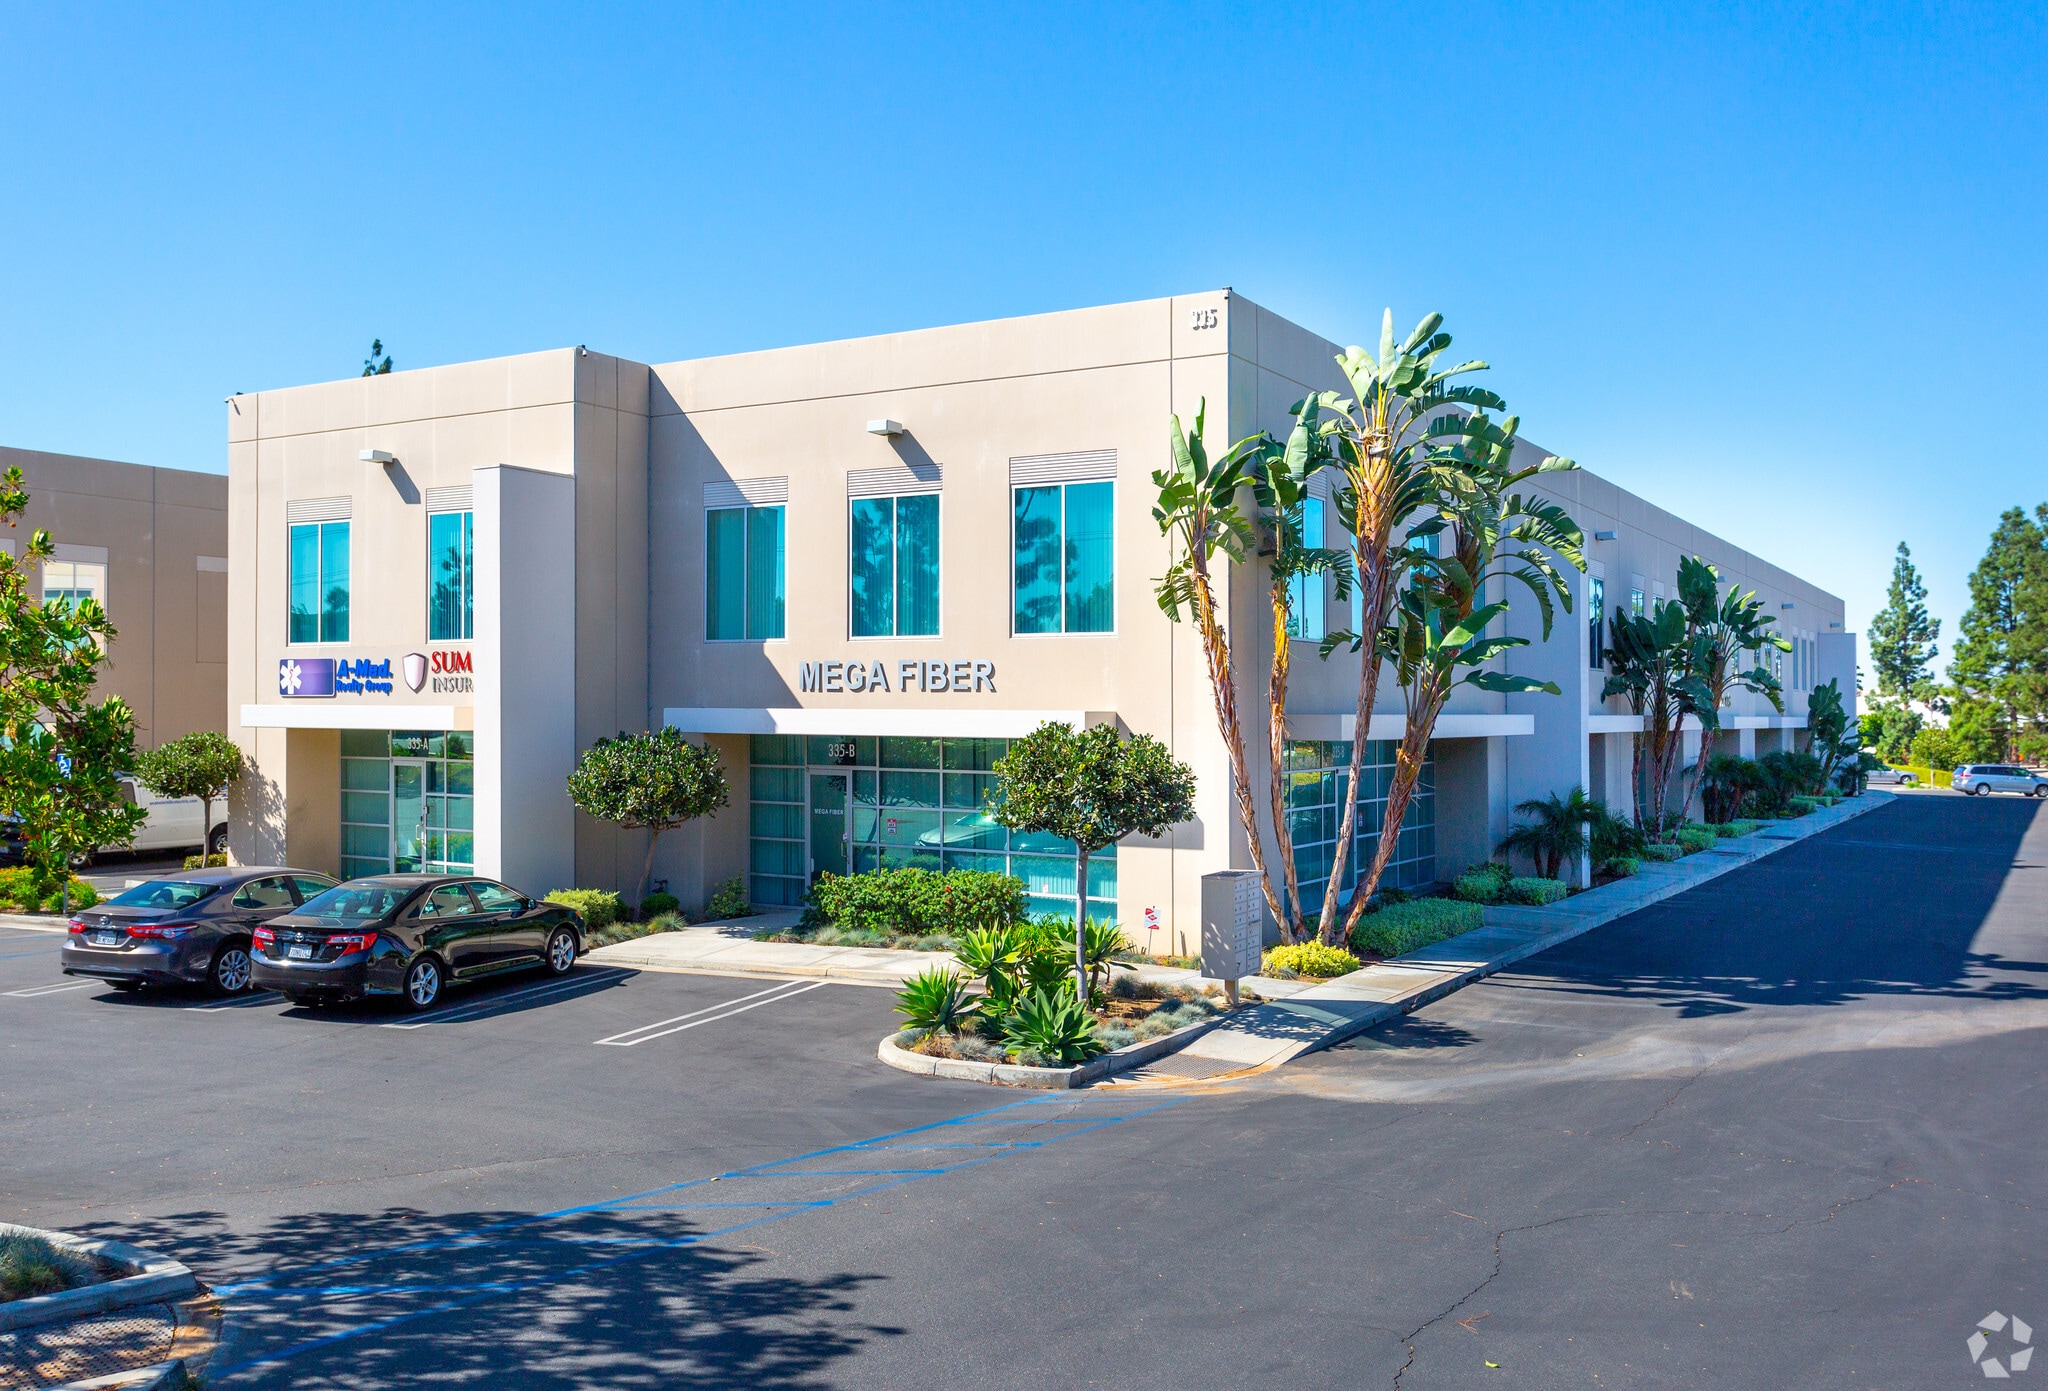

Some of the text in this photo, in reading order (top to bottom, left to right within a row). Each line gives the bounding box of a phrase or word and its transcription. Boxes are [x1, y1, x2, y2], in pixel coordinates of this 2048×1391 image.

[336, 659, 393, 679] A-Med.
[798, 658, 996, 692] MEGA FIBER
[335, 679, 393, 696] Realty Group
[407, 737, 429, 750] 335-A
[828, 744, 855, 758] 335-B
[829, 808, 844, 816] FIBER
